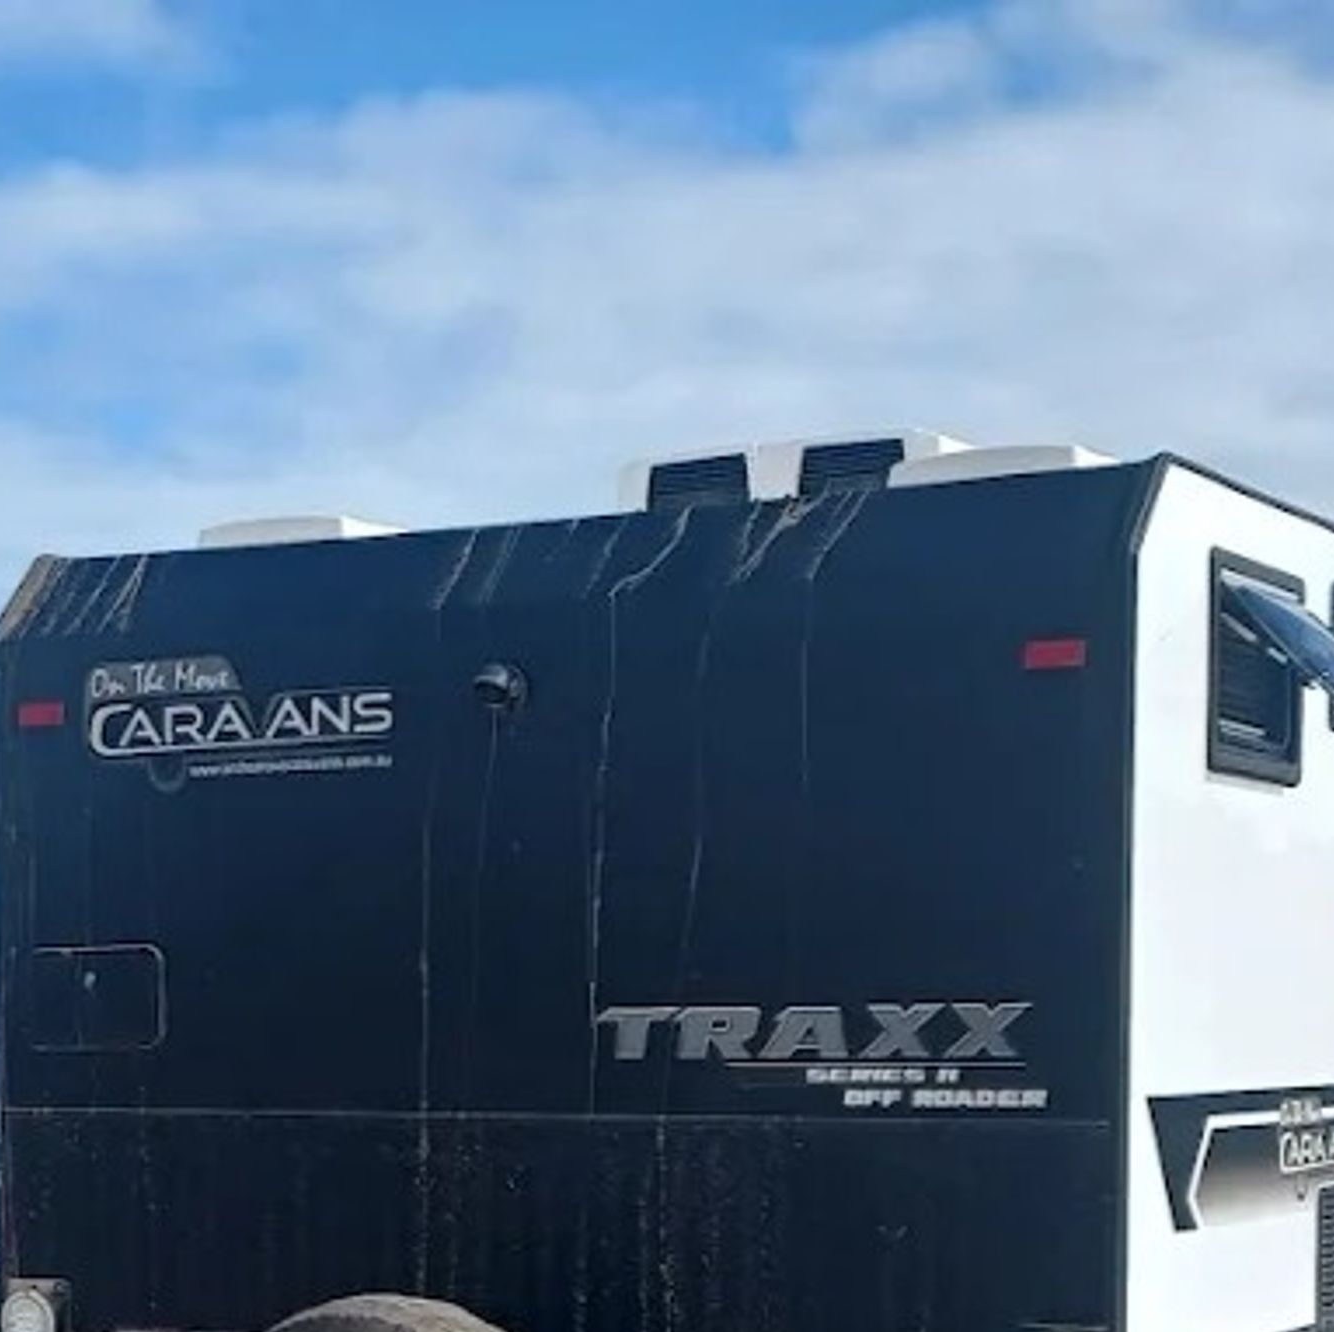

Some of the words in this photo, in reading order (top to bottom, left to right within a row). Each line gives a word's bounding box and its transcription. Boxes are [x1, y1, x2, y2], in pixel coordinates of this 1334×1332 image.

[91, 668, 125, 698] On
[131, 664, 165, 694] The
[174, 661, 229, 691] Move
[596, 1002, 1033, 1060] TRAXX
[805, 1068, 926, 1084] SERIES
[843, 1089, 902, 1107] OFF
[911, 1089, 1048, 1108] ROADER
